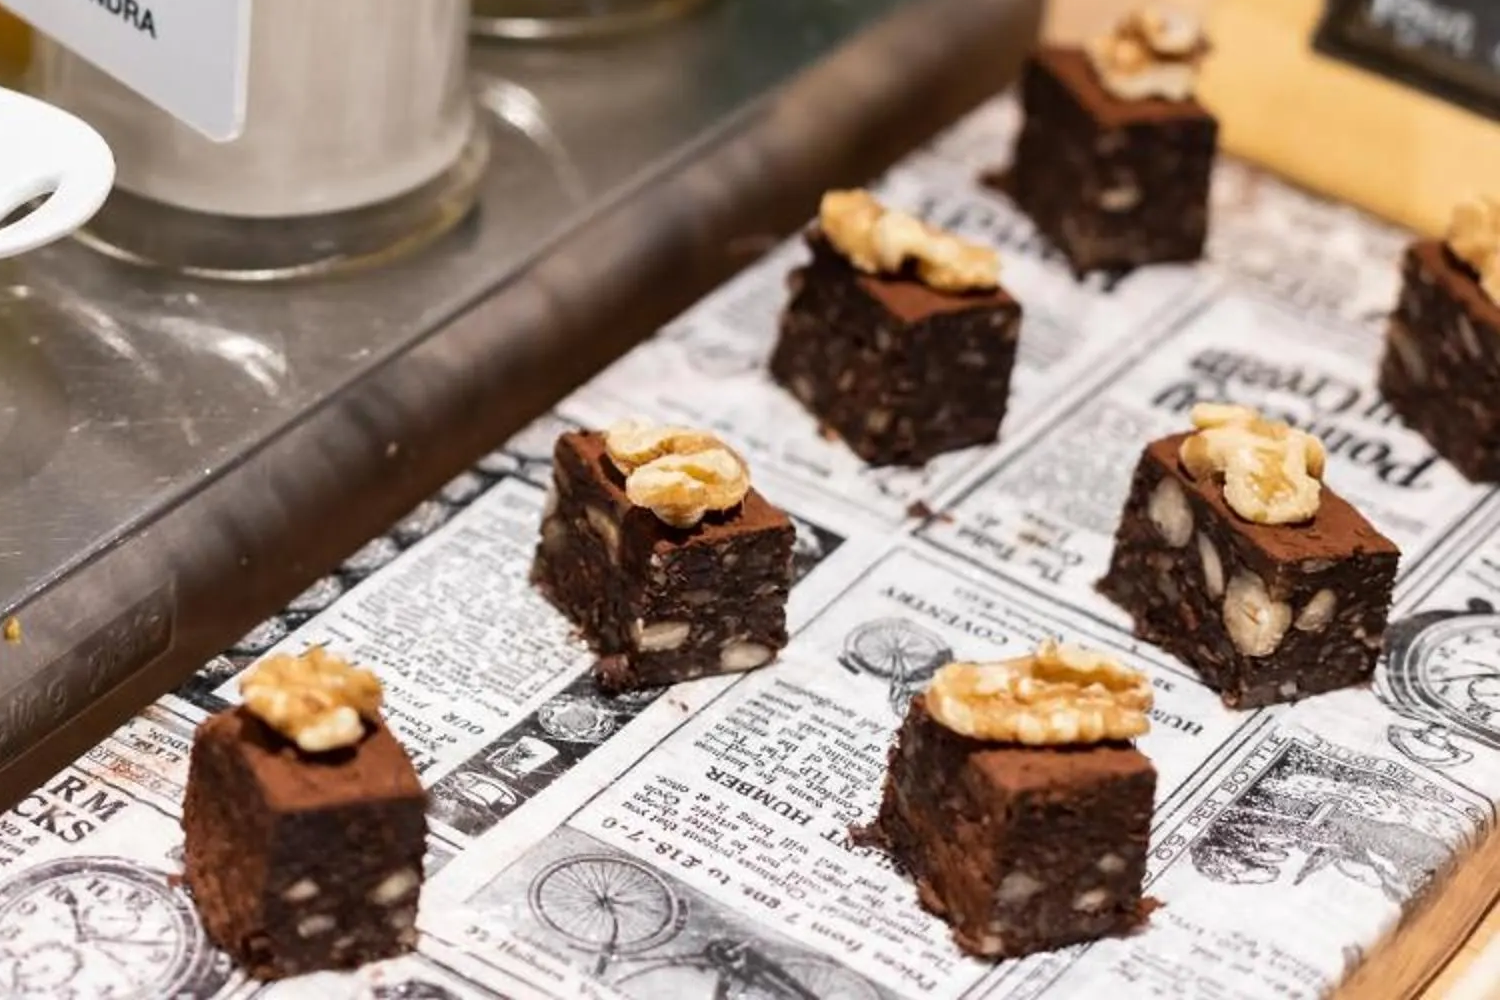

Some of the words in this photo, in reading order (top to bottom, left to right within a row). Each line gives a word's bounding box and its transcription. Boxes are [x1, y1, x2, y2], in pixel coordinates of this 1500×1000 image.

[881, 586, 1009, 645] COVENTRY
[441, 712, 485, 735] OUR
[1183, 797, 1224, 828] PER
[1218, 732, 1294, 795] BOTTLE
[621, 800, 651, 817] you
[705, 766, 813, 826] HUMBER
[648, 814, 679, 832] that
[682, 815, 725, 842] better
[690, 805, 740, 832] artistic
[735, 811, 775, 837] bring
[778, 836, 809, 855] will
[707, 867, 731, 886] to
